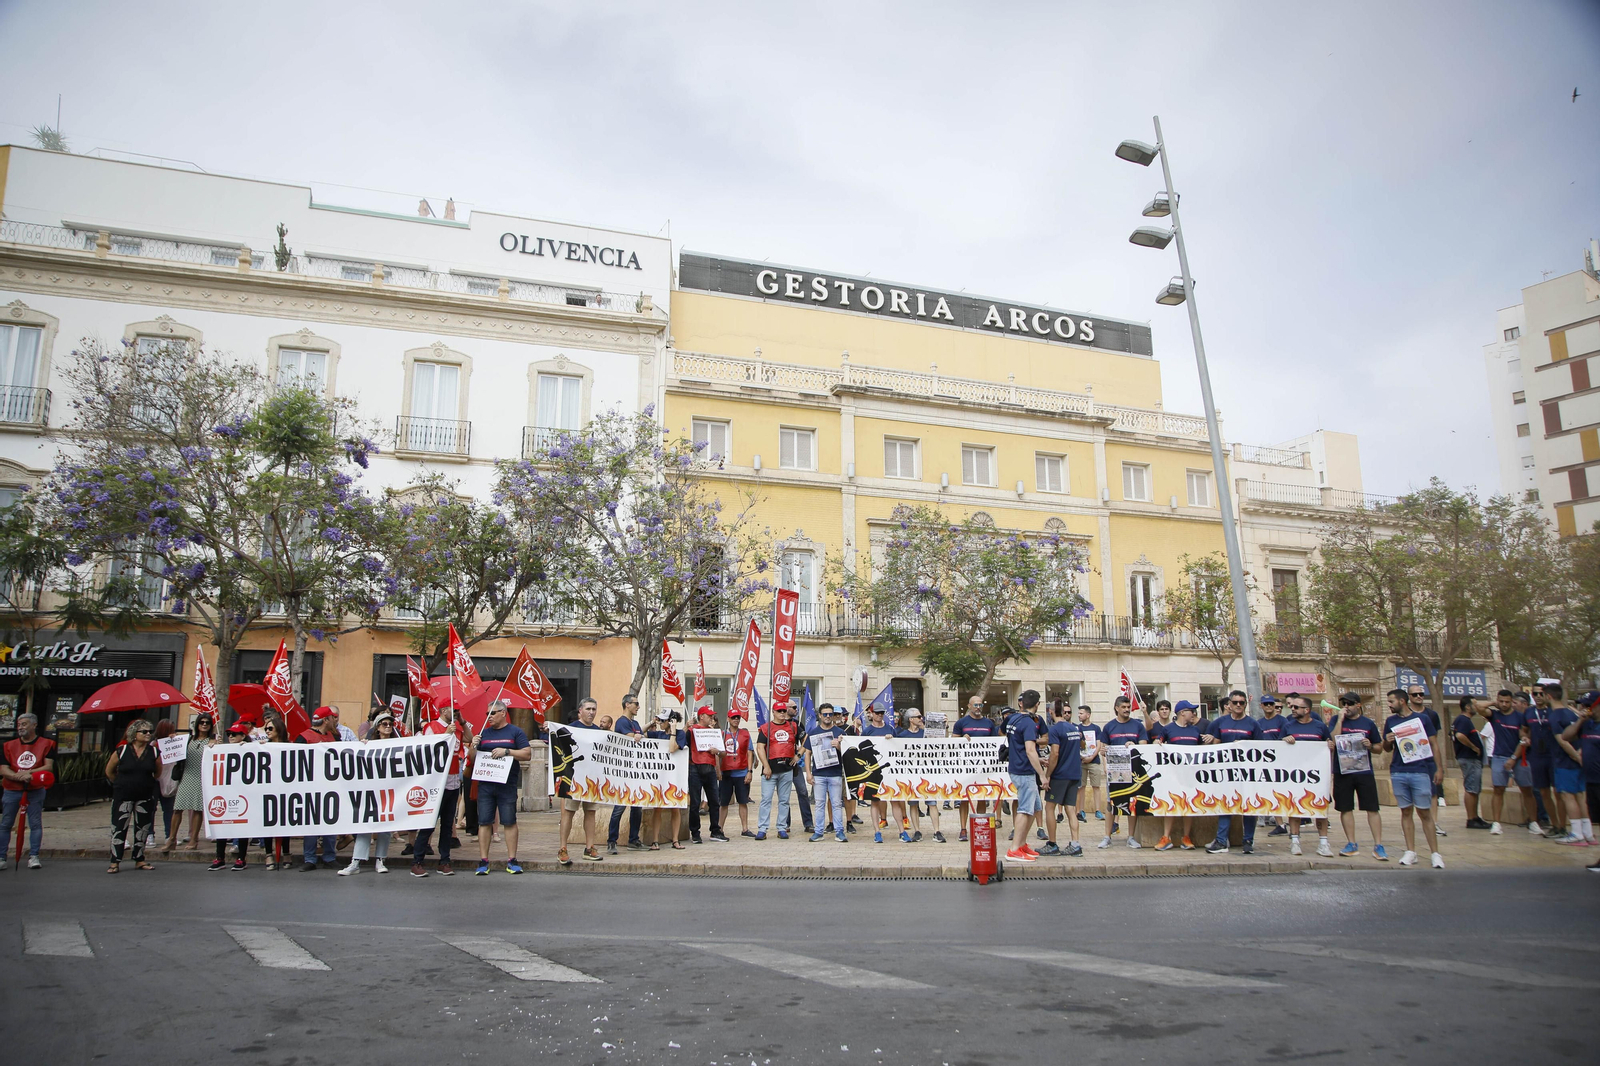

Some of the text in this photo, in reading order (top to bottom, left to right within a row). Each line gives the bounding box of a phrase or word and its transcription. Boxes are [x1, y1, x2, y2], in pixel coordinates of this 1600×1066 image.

[500, 232, 642, 271] OLIVENCIA
[756, 270, 1095, 343] GESTORIA ARCOS
[11, 640, 100, 663] Carl's Jr.
[42, 667, 99, 677] BURGERS
[101, 669, 128, 677] 1941
[1400, 675, 1418, 684] SE
[1296, 678, 1315, 687] NAILS
[1448, 686, 1464, 695] 05
[1468, 686, 1484, 695] 55
[607, 734, 618, 744] SIN
[593, 742, 603, 751] NO
[604, 744, 611, 754] SE
[612, 746, 634, 759] PUEDE
[637, 751, 656, 760] DAR
[1155, 748, 1276, 766] BOMBEROS
[281, 749, 314, 783] UN
[324, 740, 449, 781] CONVENIO
[591, 753, 675, 771] SERVICIO DE CALIDAD
[931, 758, 986, 766] VERGÜENZA
[602, 766, 659, 780] AL CIUDADANO
[1195, 768, 1321, 784] QUEMADOS
[263, 789, 395, 827] DIGNO YA!!
